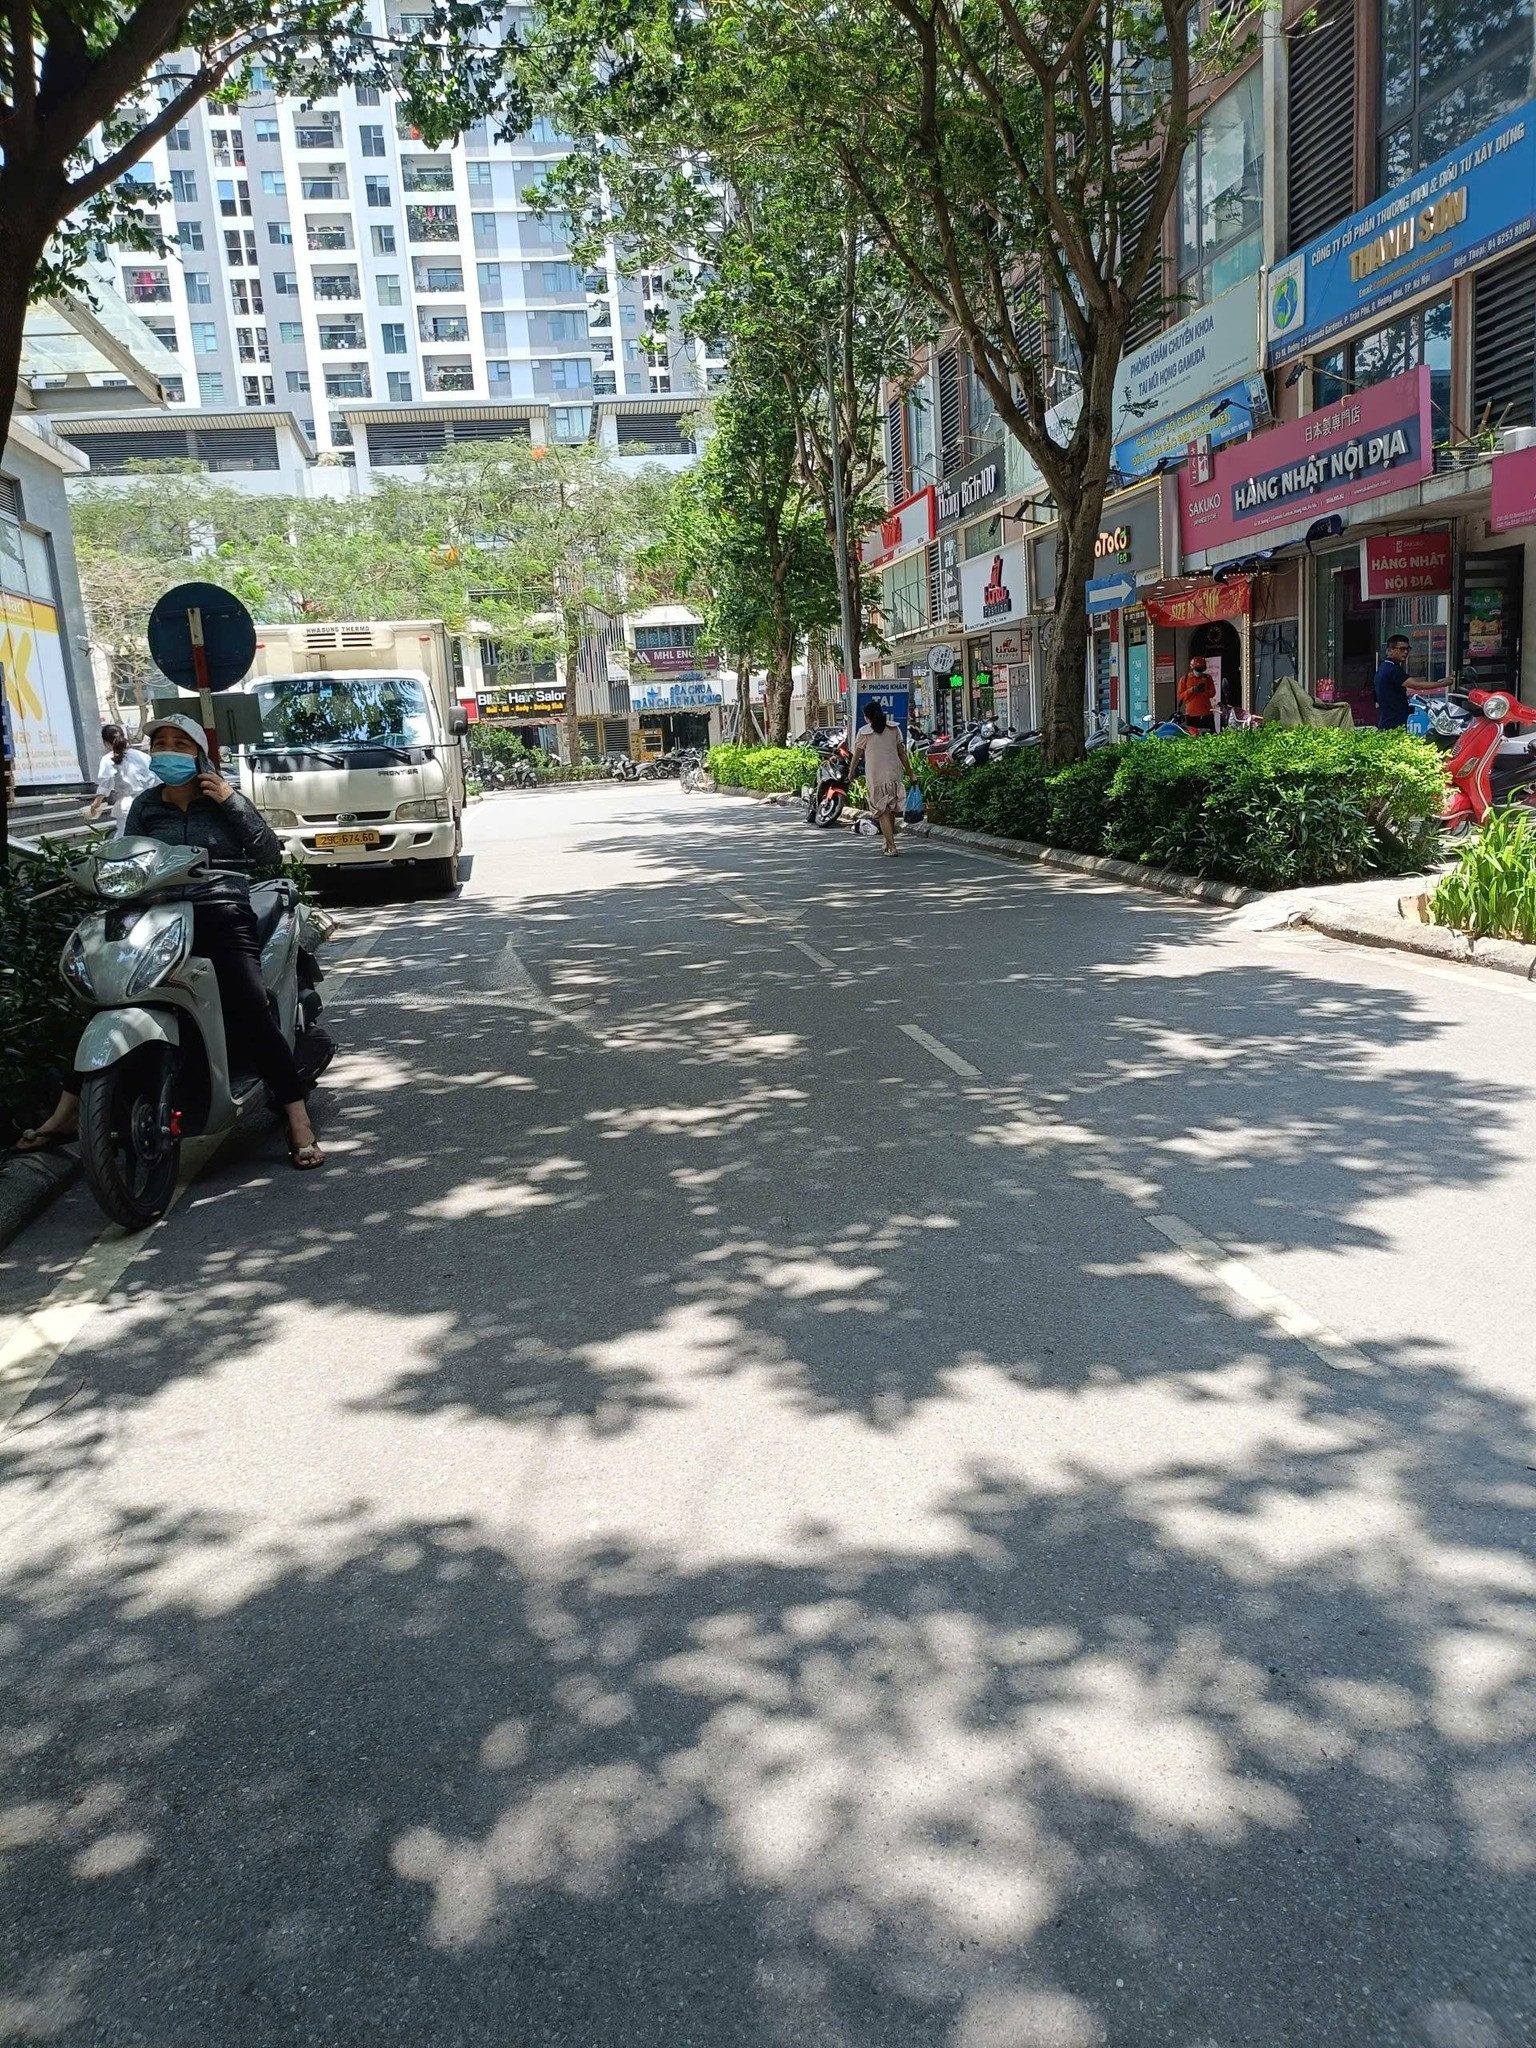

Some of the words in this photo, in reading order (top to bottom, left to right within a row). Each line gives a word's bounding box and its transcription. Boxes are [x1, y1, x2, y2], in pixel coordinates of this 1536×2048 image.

[1311, 243, 1331, 267] CÔNG
[1332, 237, 1341, 254] TY
[1430, 177, 1438, 194] &
[1460, 152, 1473, 175] TƯ
[1474, 140, 1494, 167] XÂY
[1495, 121, 1525, 153] DỰNG
[1350, 217, 1415, 283] THANH
[1130, 357, 1150, 378] PHÒNG
[1150, 343, 1168, 368] KHÁM
[1168, 326, 1194, 355] CHUYÊN
[1194, 315, 1215, 339] KHOA
[1138, 379, 1148, 397] TAI
[1159, 362, 1177, 384] HỌNG
[1178, 346, 1206, 374] GAMUDA
[1304, 405, 1361, 443] 日本製専門店
[1235, 477, 1279, 511] HÀNG
[1281, 454, 1329, 494] NHẬT
[1331, 441, 1365, 480] NỘI
[1367, 429, 1407, 469] ĐỊA
[1188, 493, 1221, 518] SAKUKO
[1371, 555, 1408, 571] HÀNG
[1409, 551, 1446, 568] NHẬT
[1384, 574, 1408, 591] NỘI
[1410, 574, 1434, 590] ĐỊA
[653, 650, 675, 660] MHL
[995, 645, 1018, 654] tina
[868, 682, 890, 691] PHÒNG
[890, 682, 907, 690] KHÁM
[697, 693, 722, 704] LONG
[871, 695, 895, 707] TAI
[378, 768, 419, 777] FRONTIER
[320, 832, 375, 845] 29C-674.60
